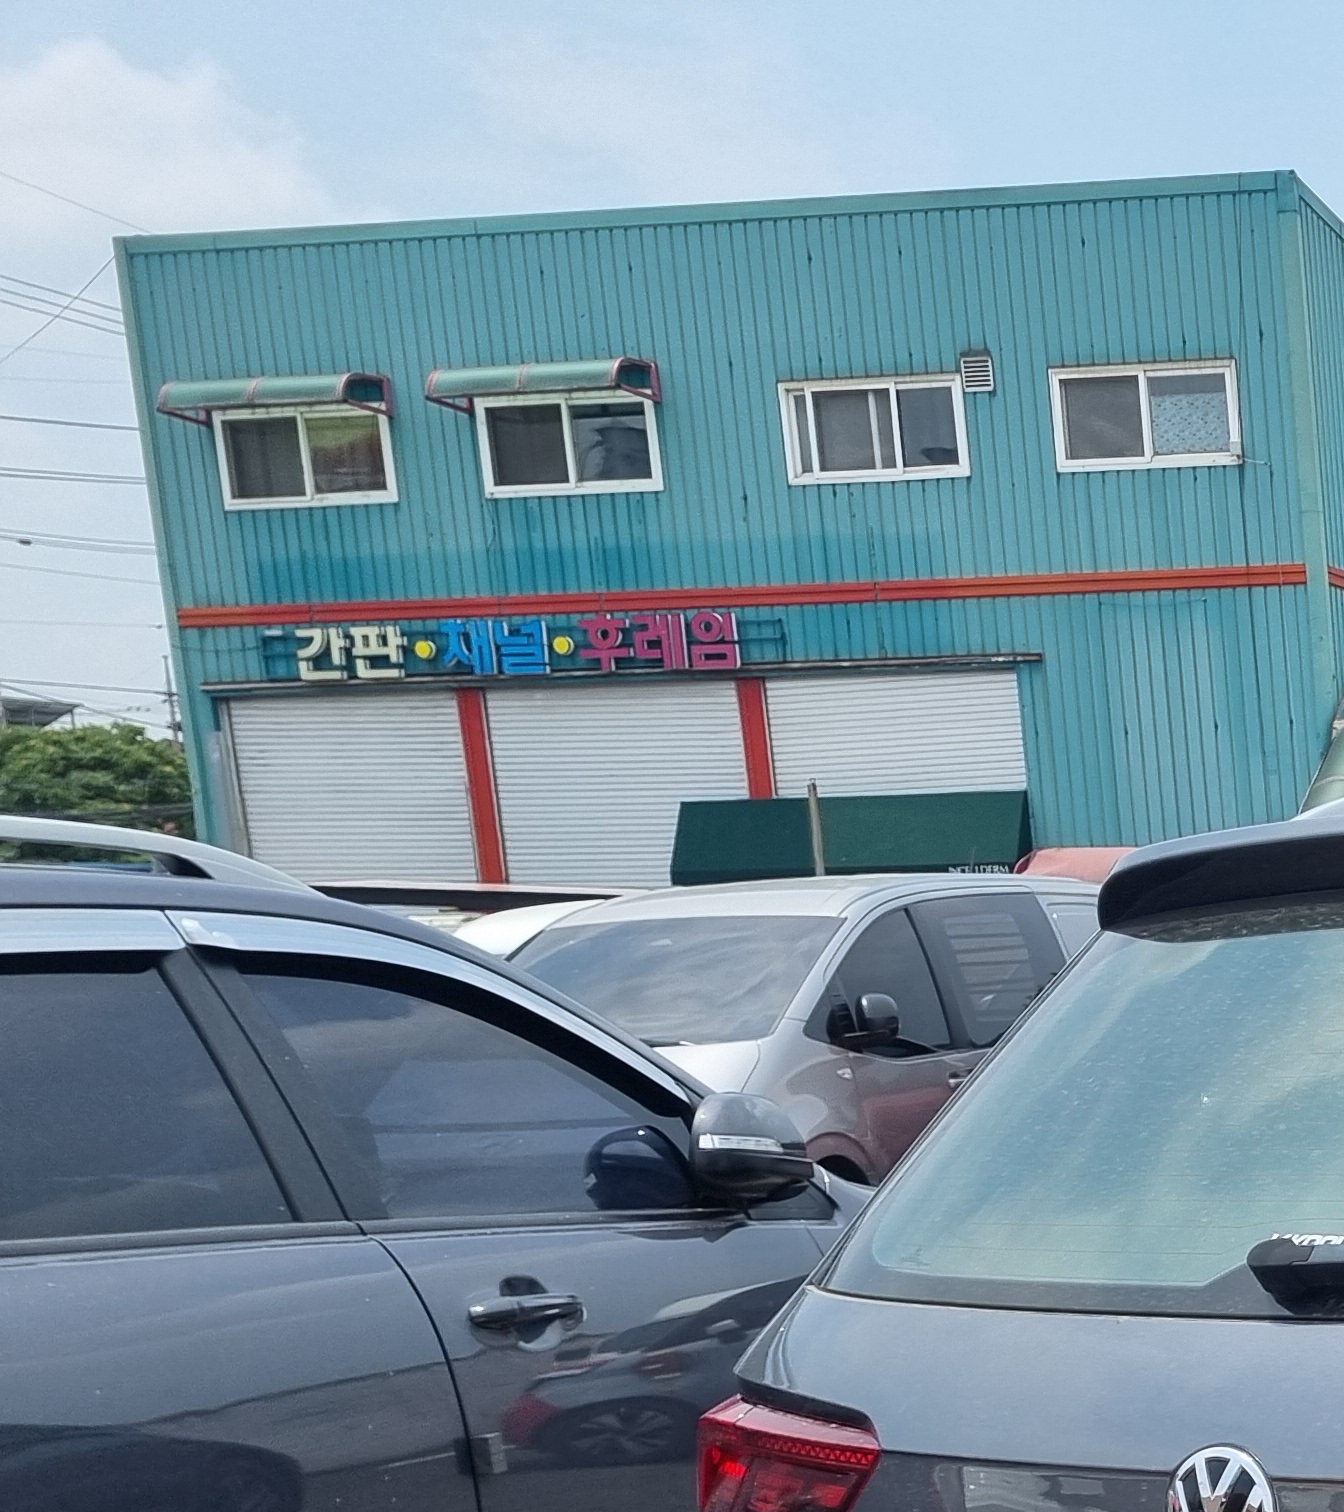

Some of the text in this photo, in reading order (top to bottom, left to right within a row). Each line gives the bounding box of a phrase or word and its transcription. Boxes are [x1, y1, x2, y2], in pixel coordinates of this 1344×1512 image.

[295, 611, 741, 681] 간판 채널 후레임
